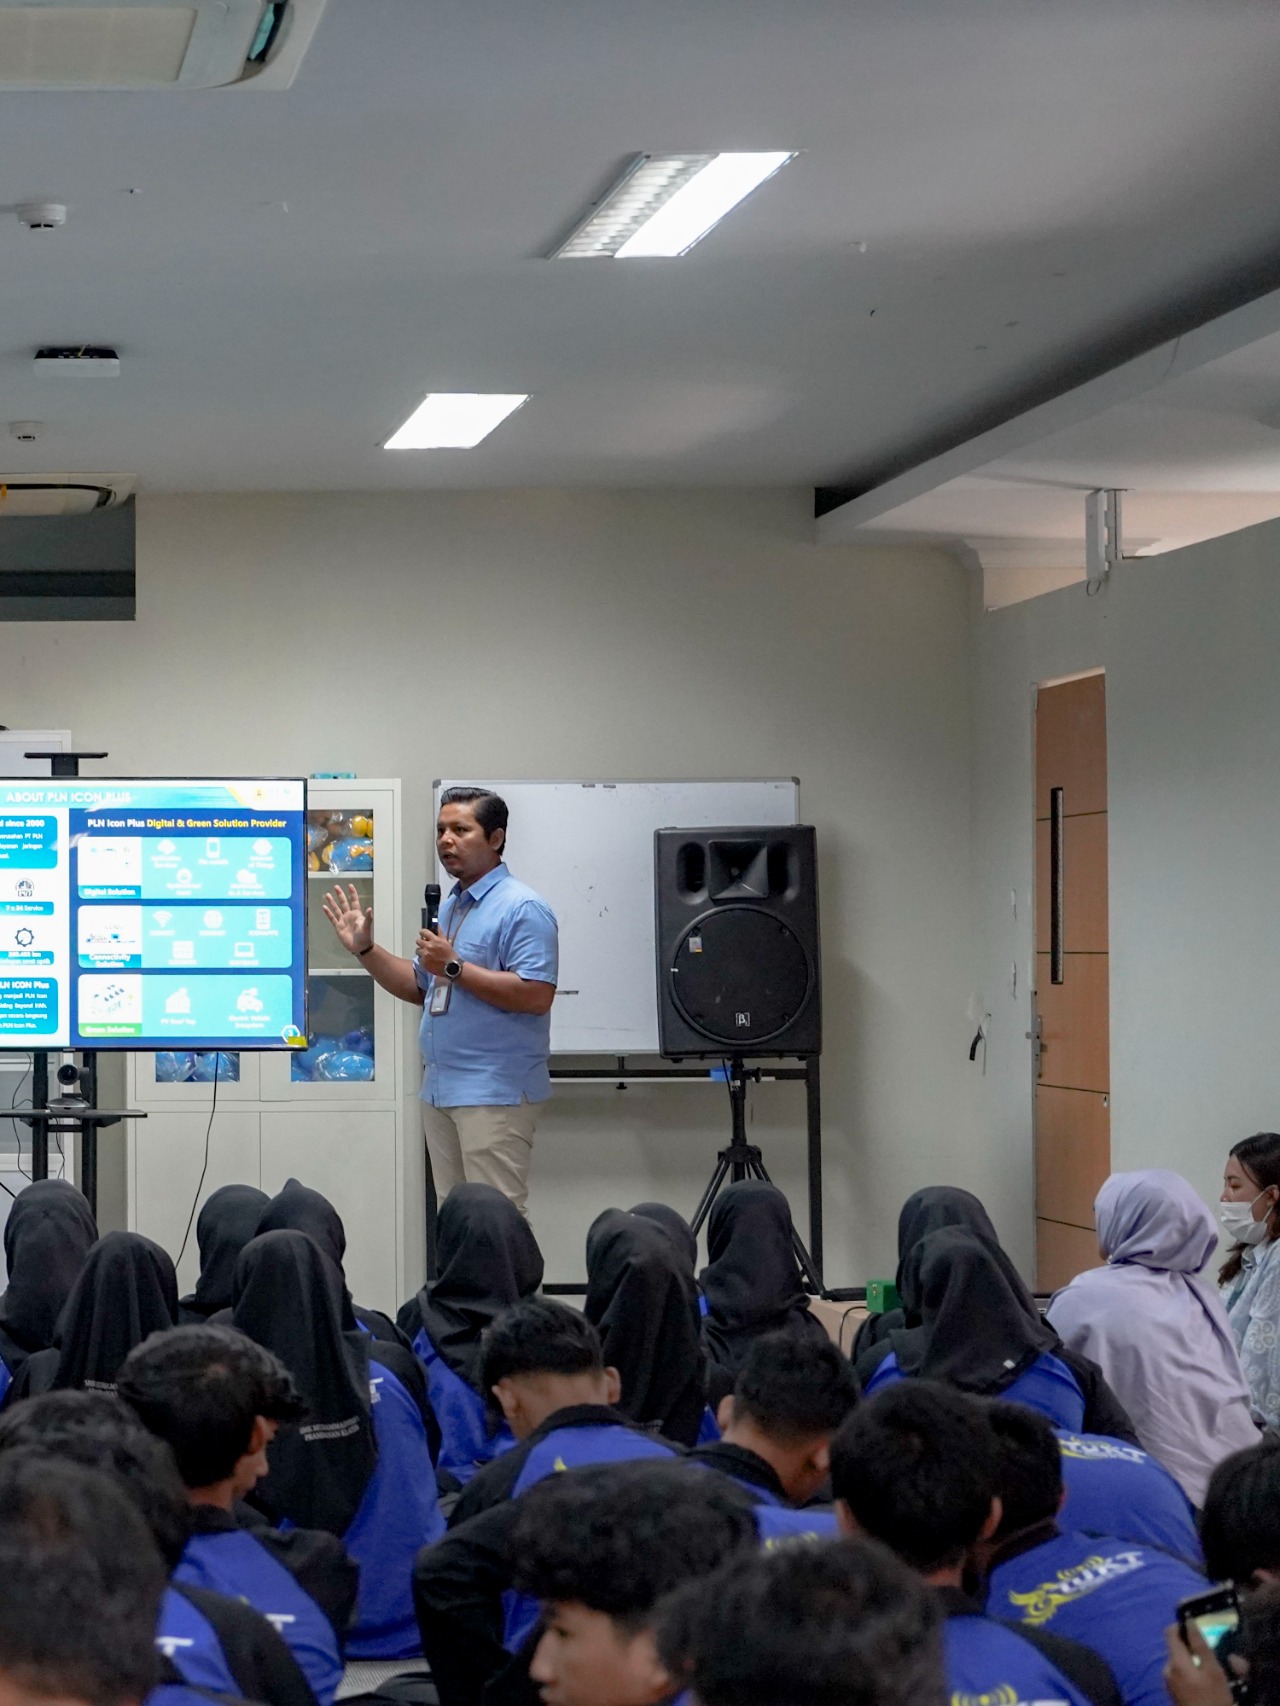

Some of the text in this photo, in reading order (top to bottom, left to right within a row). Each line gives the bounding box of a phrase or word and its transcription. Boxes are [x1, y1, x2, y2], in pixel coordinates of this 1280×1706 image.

[6, 792, 45, 802] ABOUT
[47, 792, 68, 802] PLN
[71, 792, 102, 802] ICON
[87, 819, 287, 829] PLN Icon Plus Digital & Green Solution Provider
